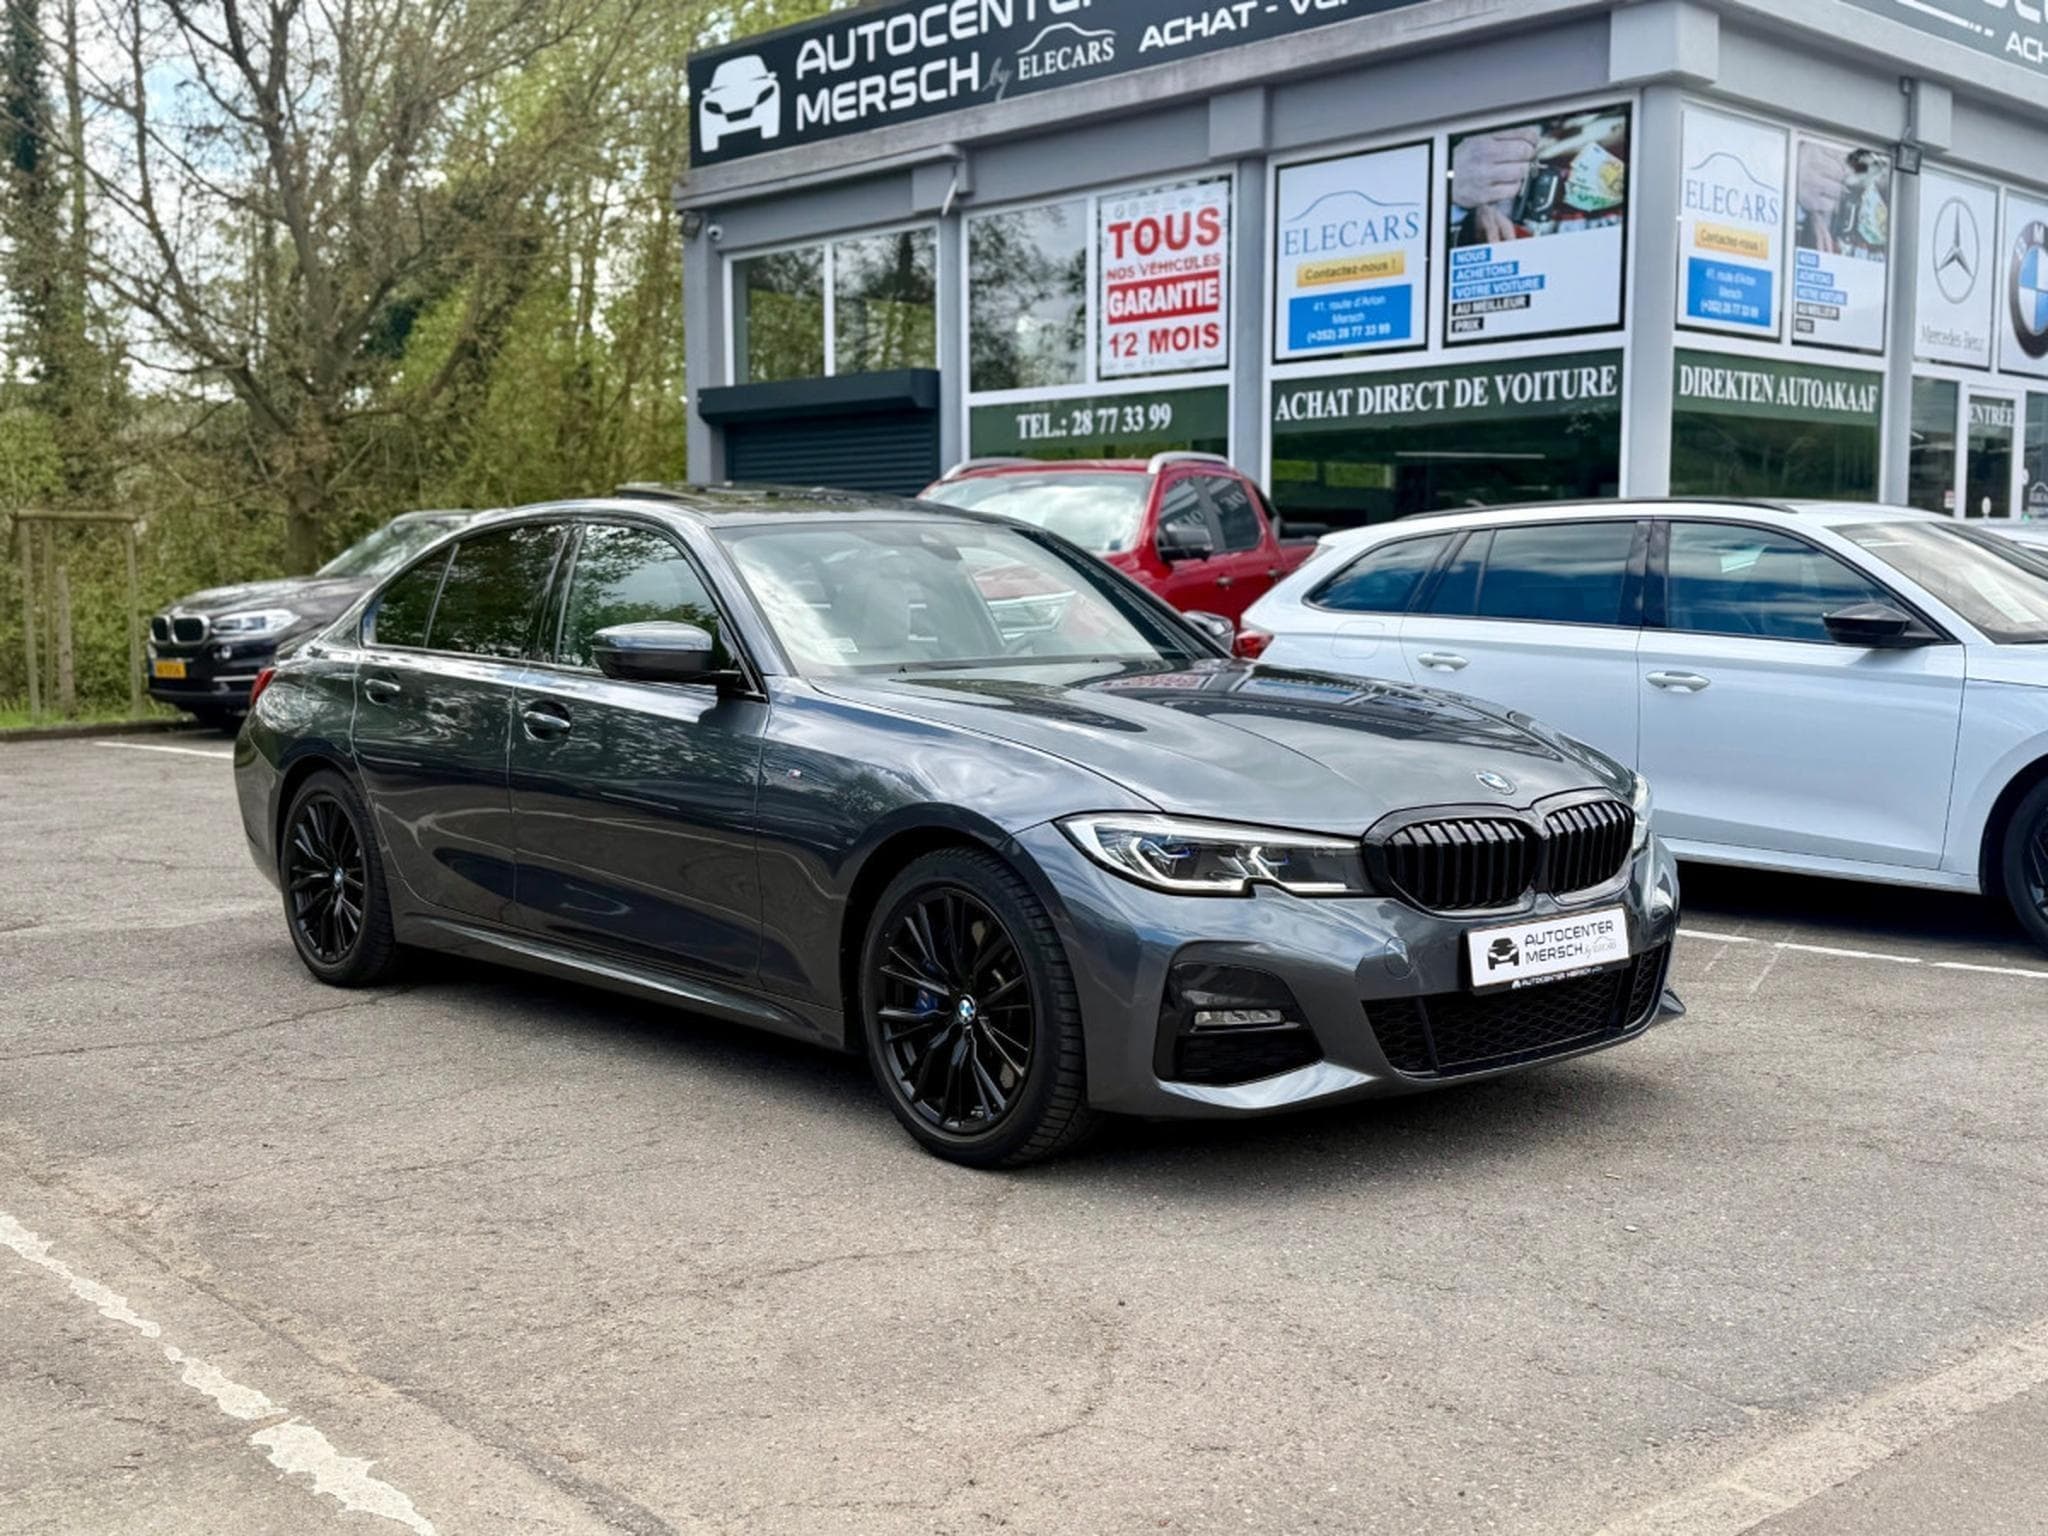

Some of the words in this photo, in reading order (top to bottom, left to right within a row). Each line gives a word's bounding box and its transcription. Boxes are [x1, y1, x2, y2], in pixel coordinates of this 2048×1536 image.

[796, 0, 1091, 80] AUTOCEN
[1139, 2, 1257, 52] ACHAT
[796, 51, 979, 131] MERSCH
[1017, 37, 1115, 80] ELECARS
[1684, 179, 1779, 225] ELECARS
[1108, 207, 1221, 259] TOUS
[1284, 212, 1420, 256] ELECARS
[1107, 265, 1136, 280] NOS
[1305, 262, 1389, 280] Contactez-nous
[1455, 263, 1515, 281] ACHETONS
[1456, 250, 1488, 264] NOUS
[1108, 278, 1218, 318] GARANTIE
[1493, 276, 1540, 294] VOITURE
[1109, 331, 1138, 358] 12
[1149, 322, 1220, 355] MOIS
[1275, 388, 1353, 421] ACHAT
[1357, 379, 1449, 415] DIRECT
[1454, 376, 1488, 408] DE
[1495, 365, 1617, 404] VOITURE
[1680, 365, 1774, 402] DIREKTEN
[1776, 376, 1878, 413] AUTOAKAAF
[1072, 410, 1093, 436] 28
[1099, 407, 1118, 434] 77
[1122, 404, 1144, 432] 33
[1149, 403, 1172, 430] 99
[1525, 920, 1613, 947] AUTOCENTER
[1525, 943, 1583, 965] MERSCH
